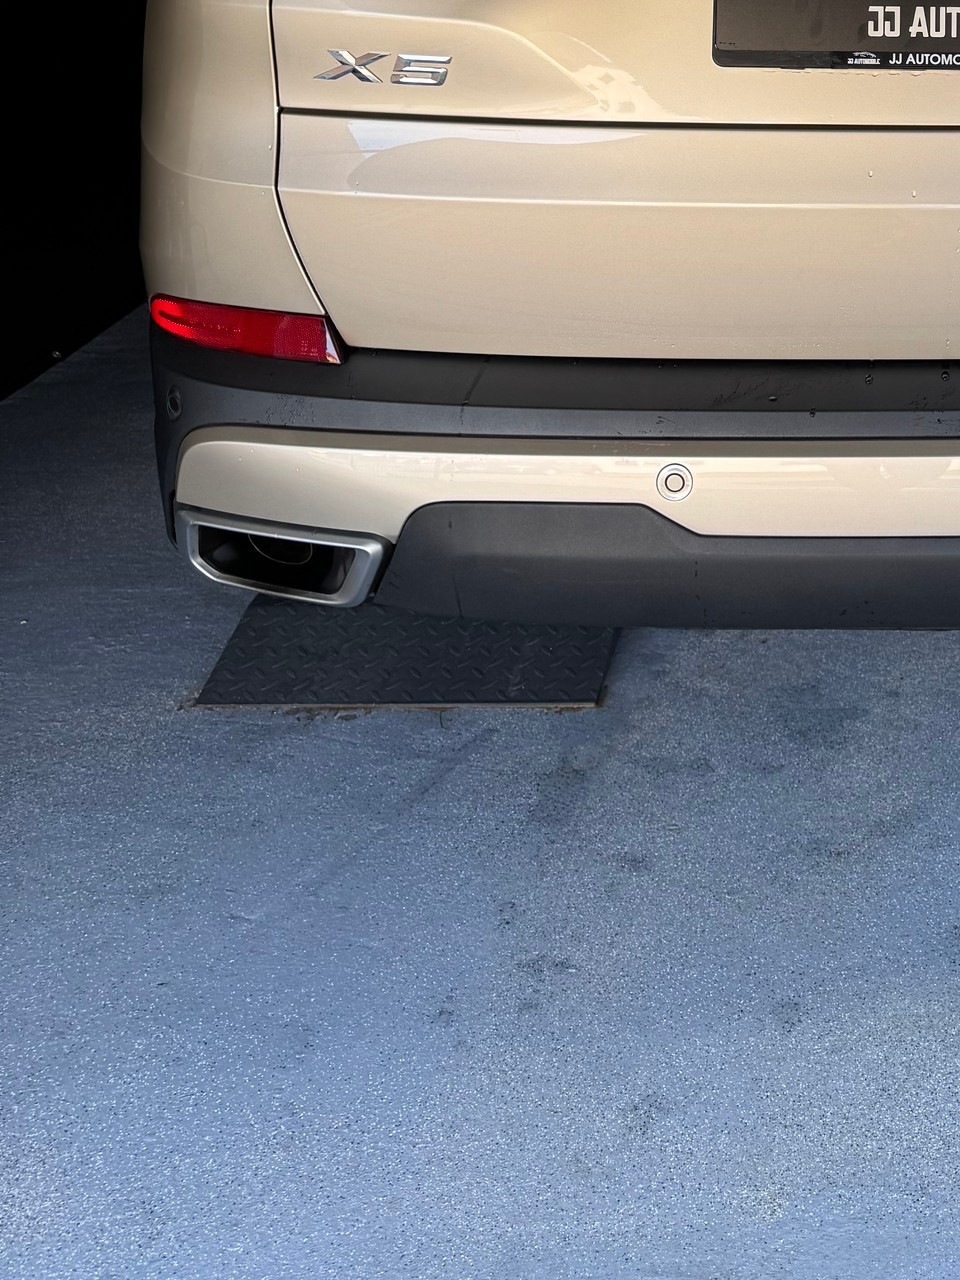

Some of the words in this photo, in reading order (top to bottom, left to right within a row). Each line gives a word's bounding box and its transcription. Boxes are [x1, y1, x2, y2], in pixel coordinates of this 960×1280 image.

[868, 5, 901, 38] JJ
[312, 48, 453, 87] X5
[888, 53, 903, 65] JJ
